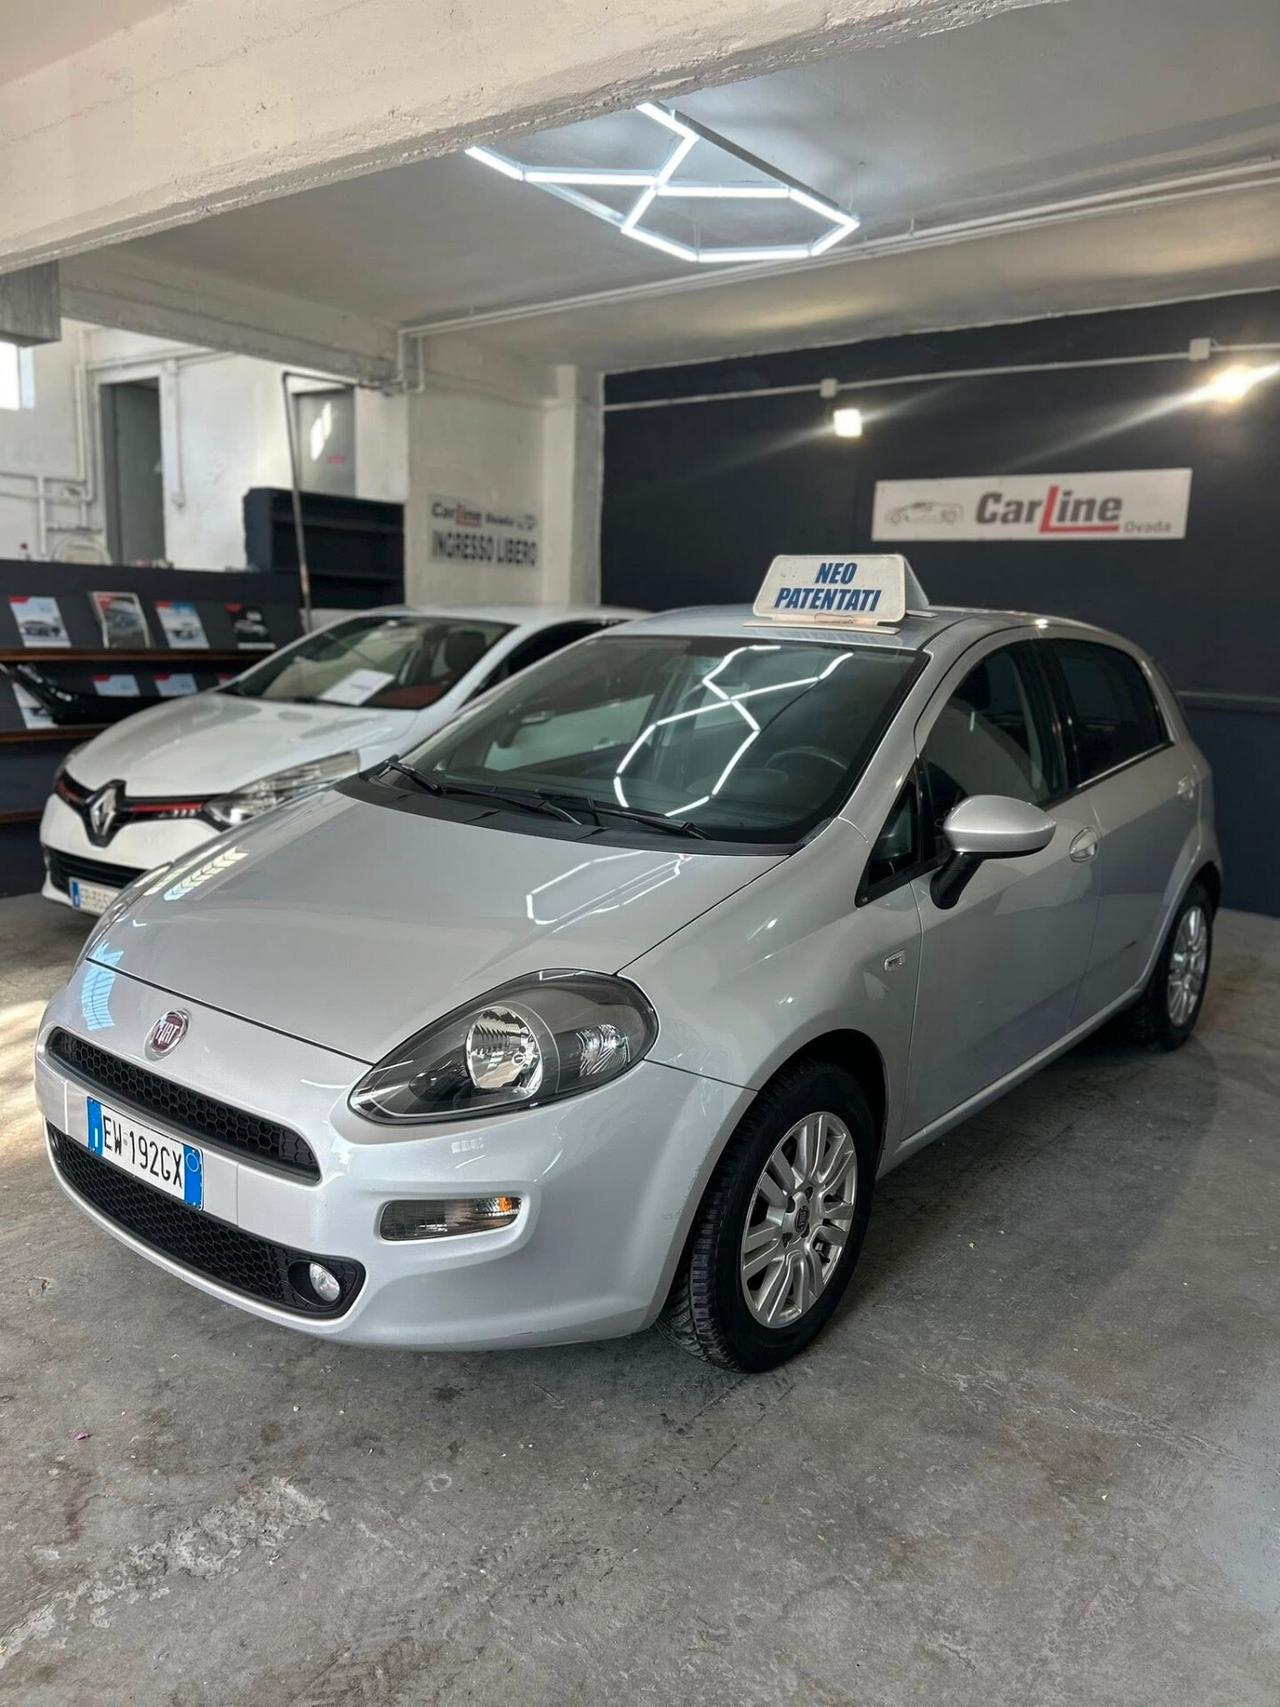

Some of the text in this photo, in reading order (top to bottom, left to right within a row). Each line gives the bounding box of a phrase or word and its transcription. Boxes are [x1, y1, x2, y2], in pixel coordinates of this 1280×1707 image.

[975, 485, 1172, 534] CarLine Ovada
[431, 530, 537, 566] INGRESSO LIBERO
[814, 562, 858, 585] NEO
[773, 587, 882, 612] PATENTATI
[155, 1021, 180, 1045] FIAT
